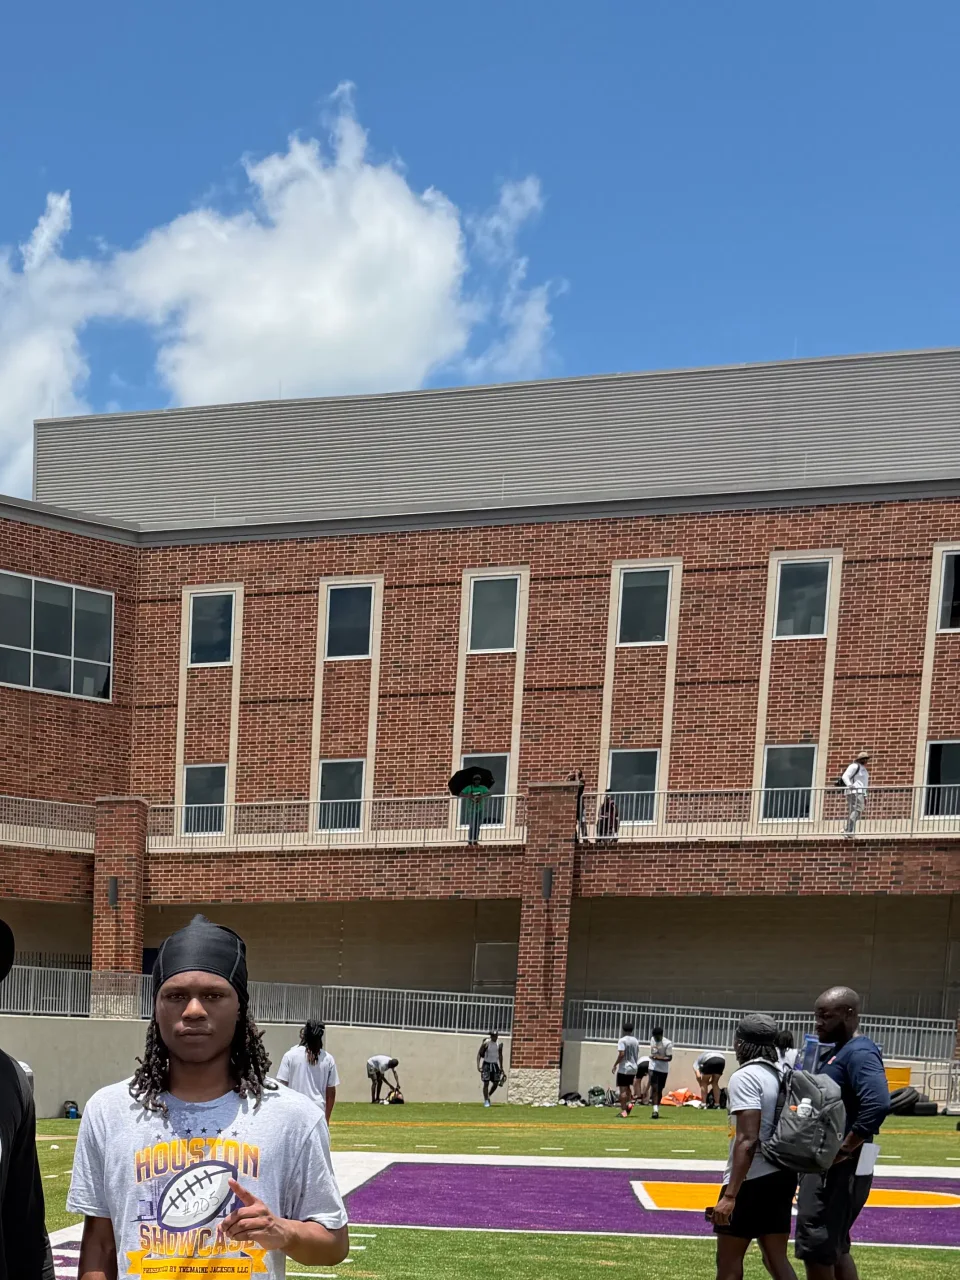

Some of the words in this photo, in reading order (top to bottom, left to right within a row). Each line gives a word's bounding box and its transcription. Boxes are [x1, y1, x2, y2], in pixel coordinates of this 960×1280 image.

[134, 1137, 261, 1184] HOUSTON
[182, 1190, 220, 1218] #205
[169, 1265, 177, 1273] BY
[209, 1266, 235, 1274] JACKSON
[236, 1266, 249, 1274] LLC
